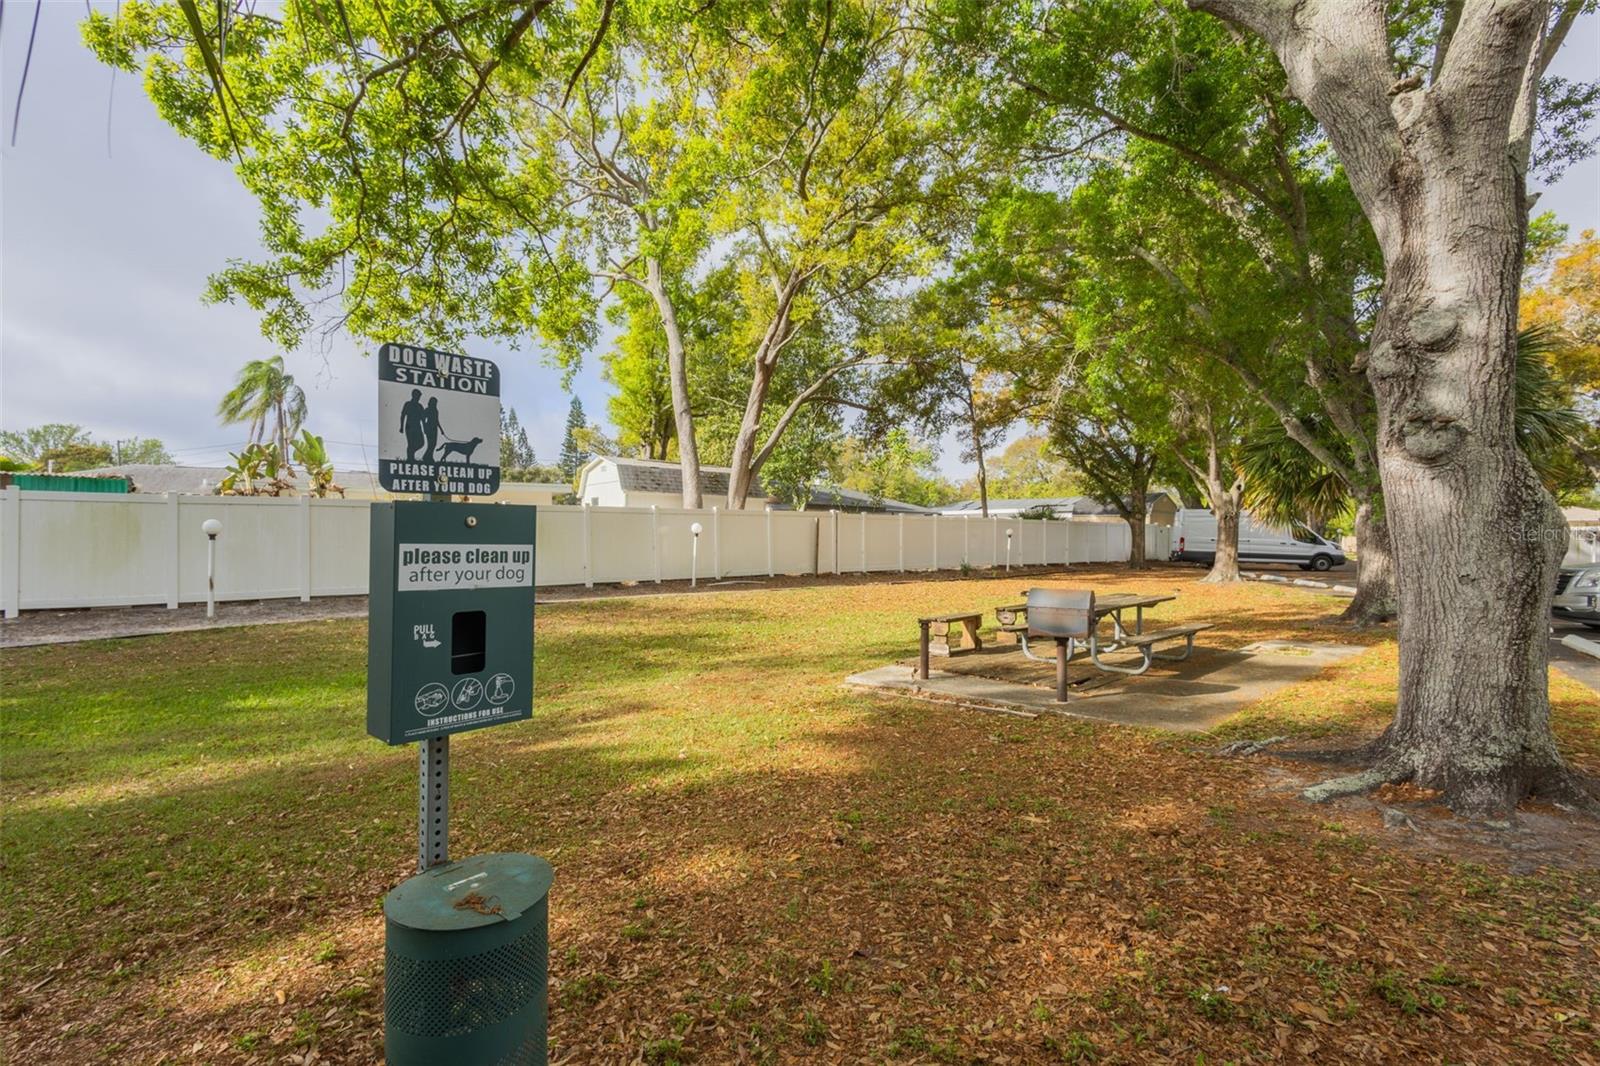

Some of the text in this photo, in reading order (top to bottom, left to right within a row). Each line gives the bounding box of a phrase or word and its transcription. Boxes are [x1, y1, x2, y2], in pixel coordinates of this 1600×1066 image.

[389, 345, 493, 378] DOG WASTE
[396, 368, 487, 394] STATION
[390, 463, 492, 479] PLEASE CLEAN UP
[392, 479, 491, 494] AFTER YOUR DOG
[403, 548, 530, 566] please clean up
[409, 565, 525, 584] after your dog
[414, 624, 434, 634] PULL
[427, 712, 477, 727] INSTRUCTIONS
[478, 709, 490, 717] FOR
